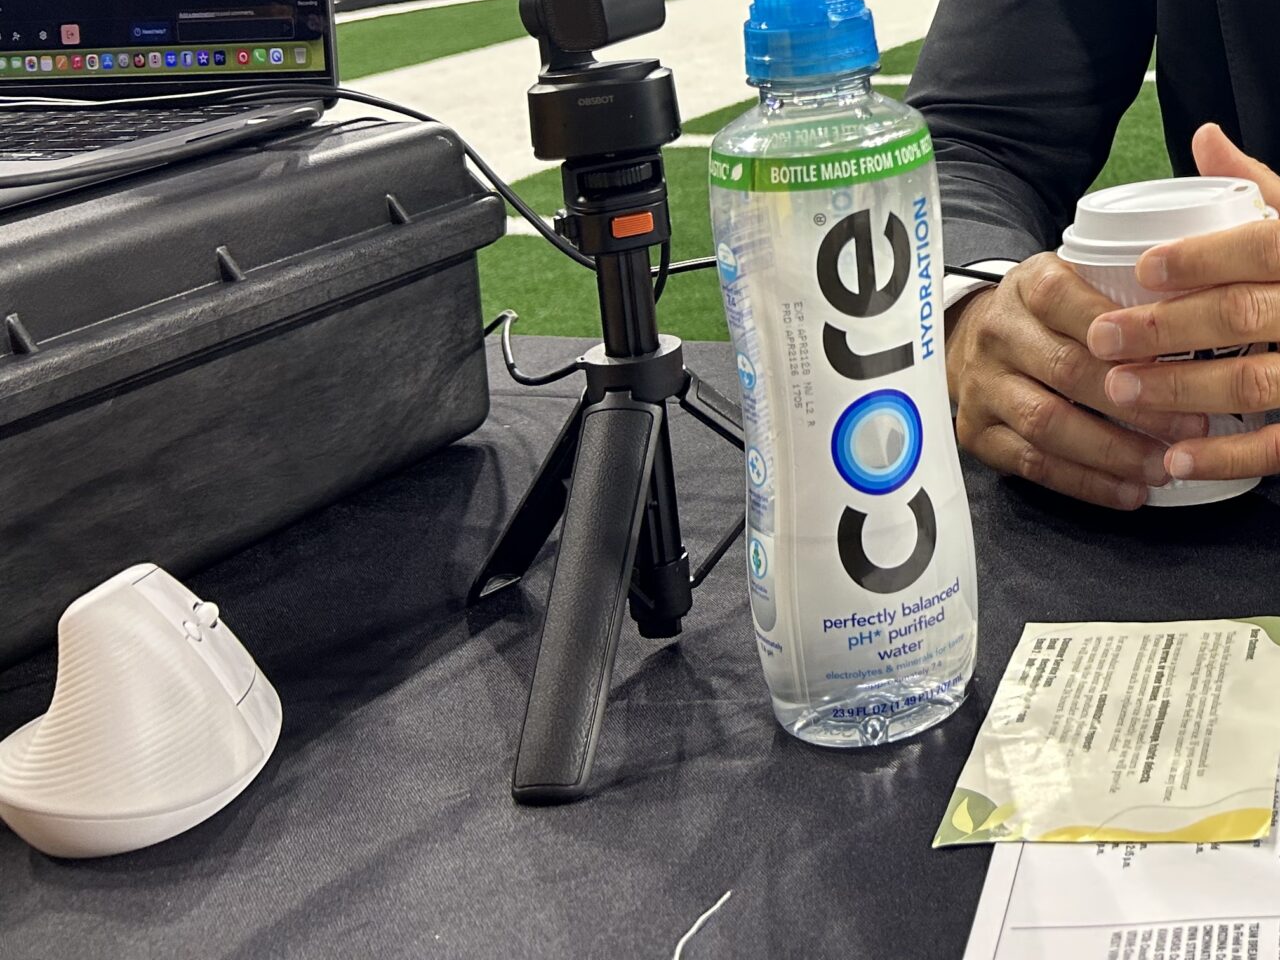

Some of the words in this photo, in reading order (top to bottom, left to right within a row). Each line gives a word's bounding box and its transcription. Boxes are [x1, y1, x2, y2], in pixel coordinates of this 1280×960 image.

[578, 95, 614, 106] OBSBOT
[771, 166, 817, 183] BOTTLE
[821, 161, 857, 180] MADE
[860, 155, 893, 174] FROM
[894, 145, 920, 166] 100%
[911, 196, 936, 361] HYDRATION
[816, 208, 938, 597] core
[823, 608, 896, 632] perfectly
[902, 576, 960, 618] balanced
[888, 607, 945, 643] purified
[826, 668, 882, 680] electrolytes
[886, 665, 893, 673] &
[897, 652, 933, 670] minerals
[935, 646, 946, 656] for
[878, 639, 923, 660] water
[833, 706, 854, 718] 23.9
[856, 705, 868, 716] FL
[872, 704, 886, 715] OZ
[890, 696, 916, 712] (1.49
